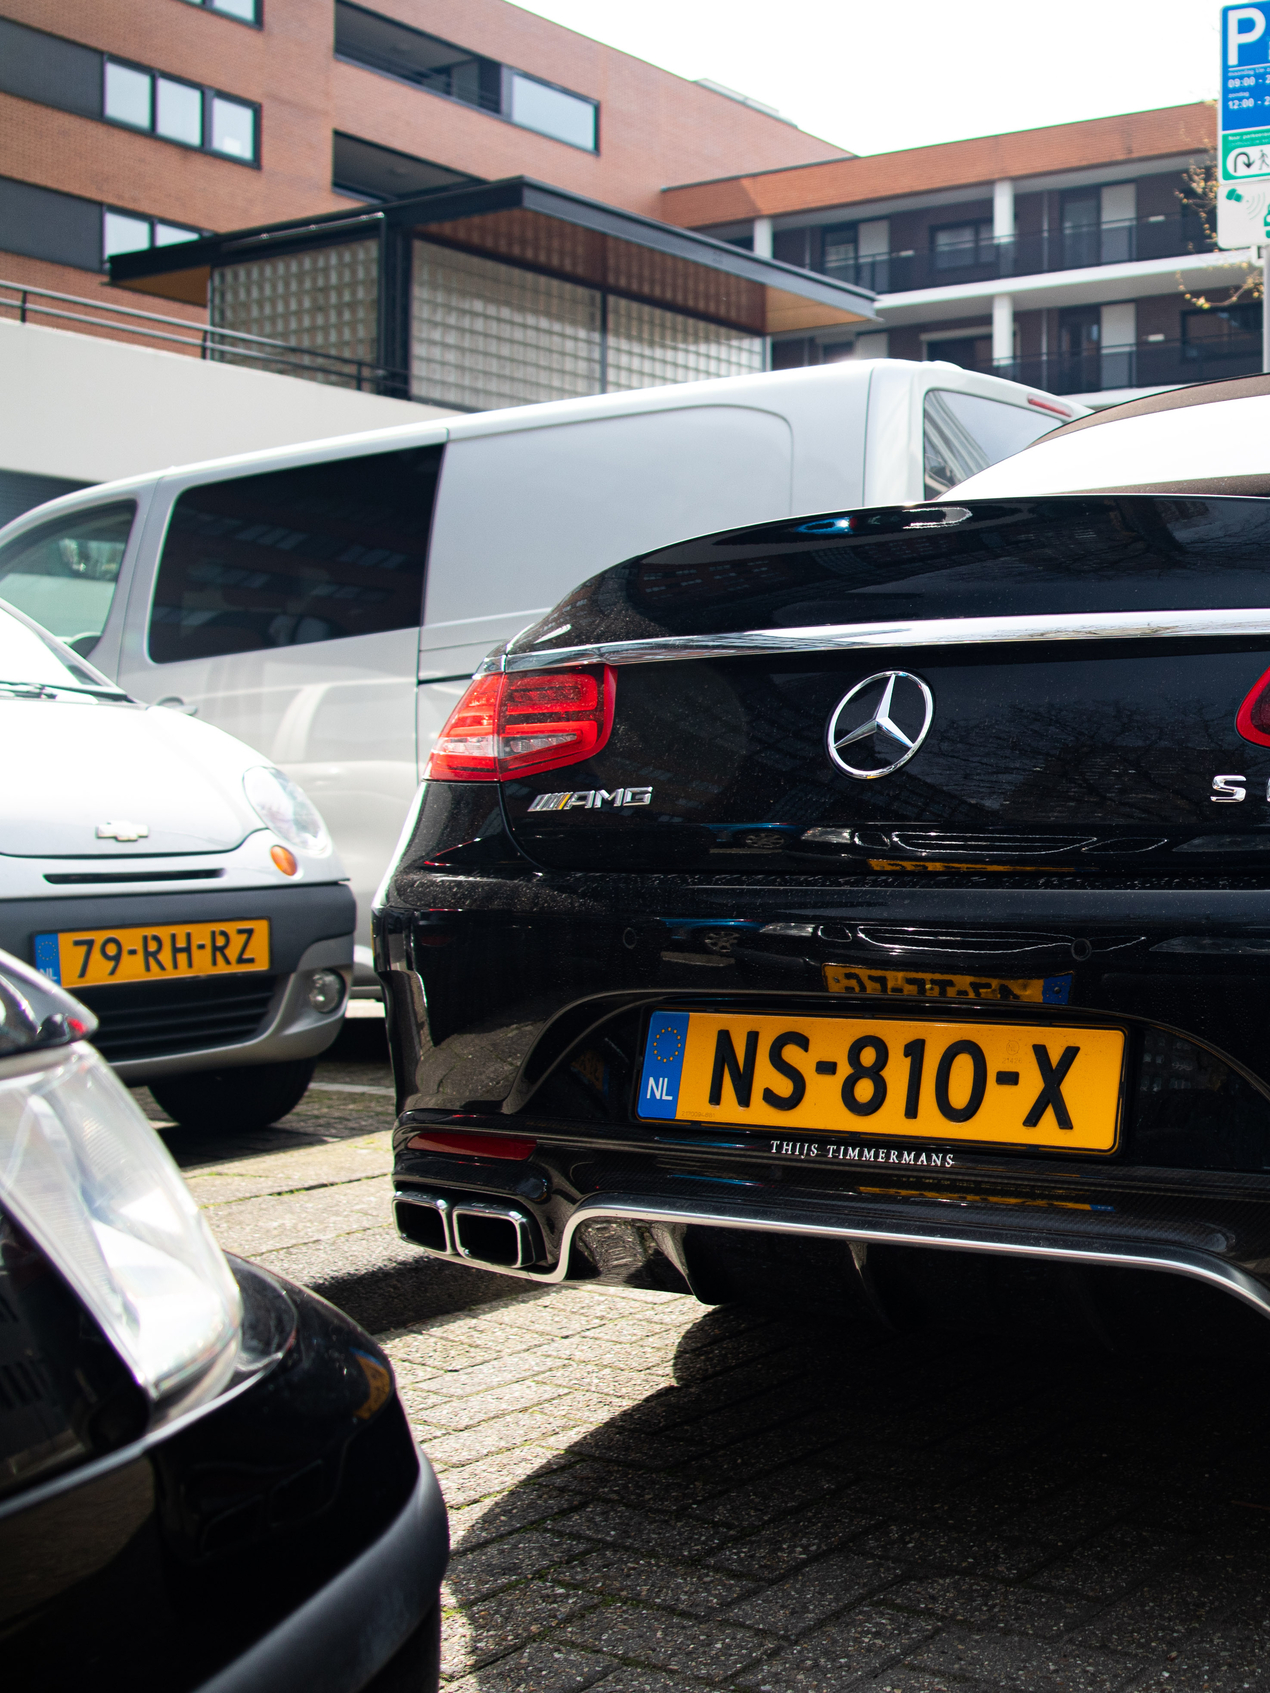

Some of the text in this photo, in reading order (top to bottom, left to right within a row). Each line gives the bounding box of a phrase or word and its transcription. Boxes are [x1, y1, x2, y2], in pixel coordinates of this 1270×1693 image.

[1228, 7, 1266, 65] P
[1228, 76, 1256, 88] 09:00
[1228, 97, 1254, 109] 12:00
[1210, 774, 1247, 803] S
[72, 927, 256, 979] 79-RH-RZ
[646, 1076, 673, 1101] NL
[708, 1028, 1081, 1131] NS-810-X
[770, 1140, 955, 1168] THIJS TIMMERMANS
